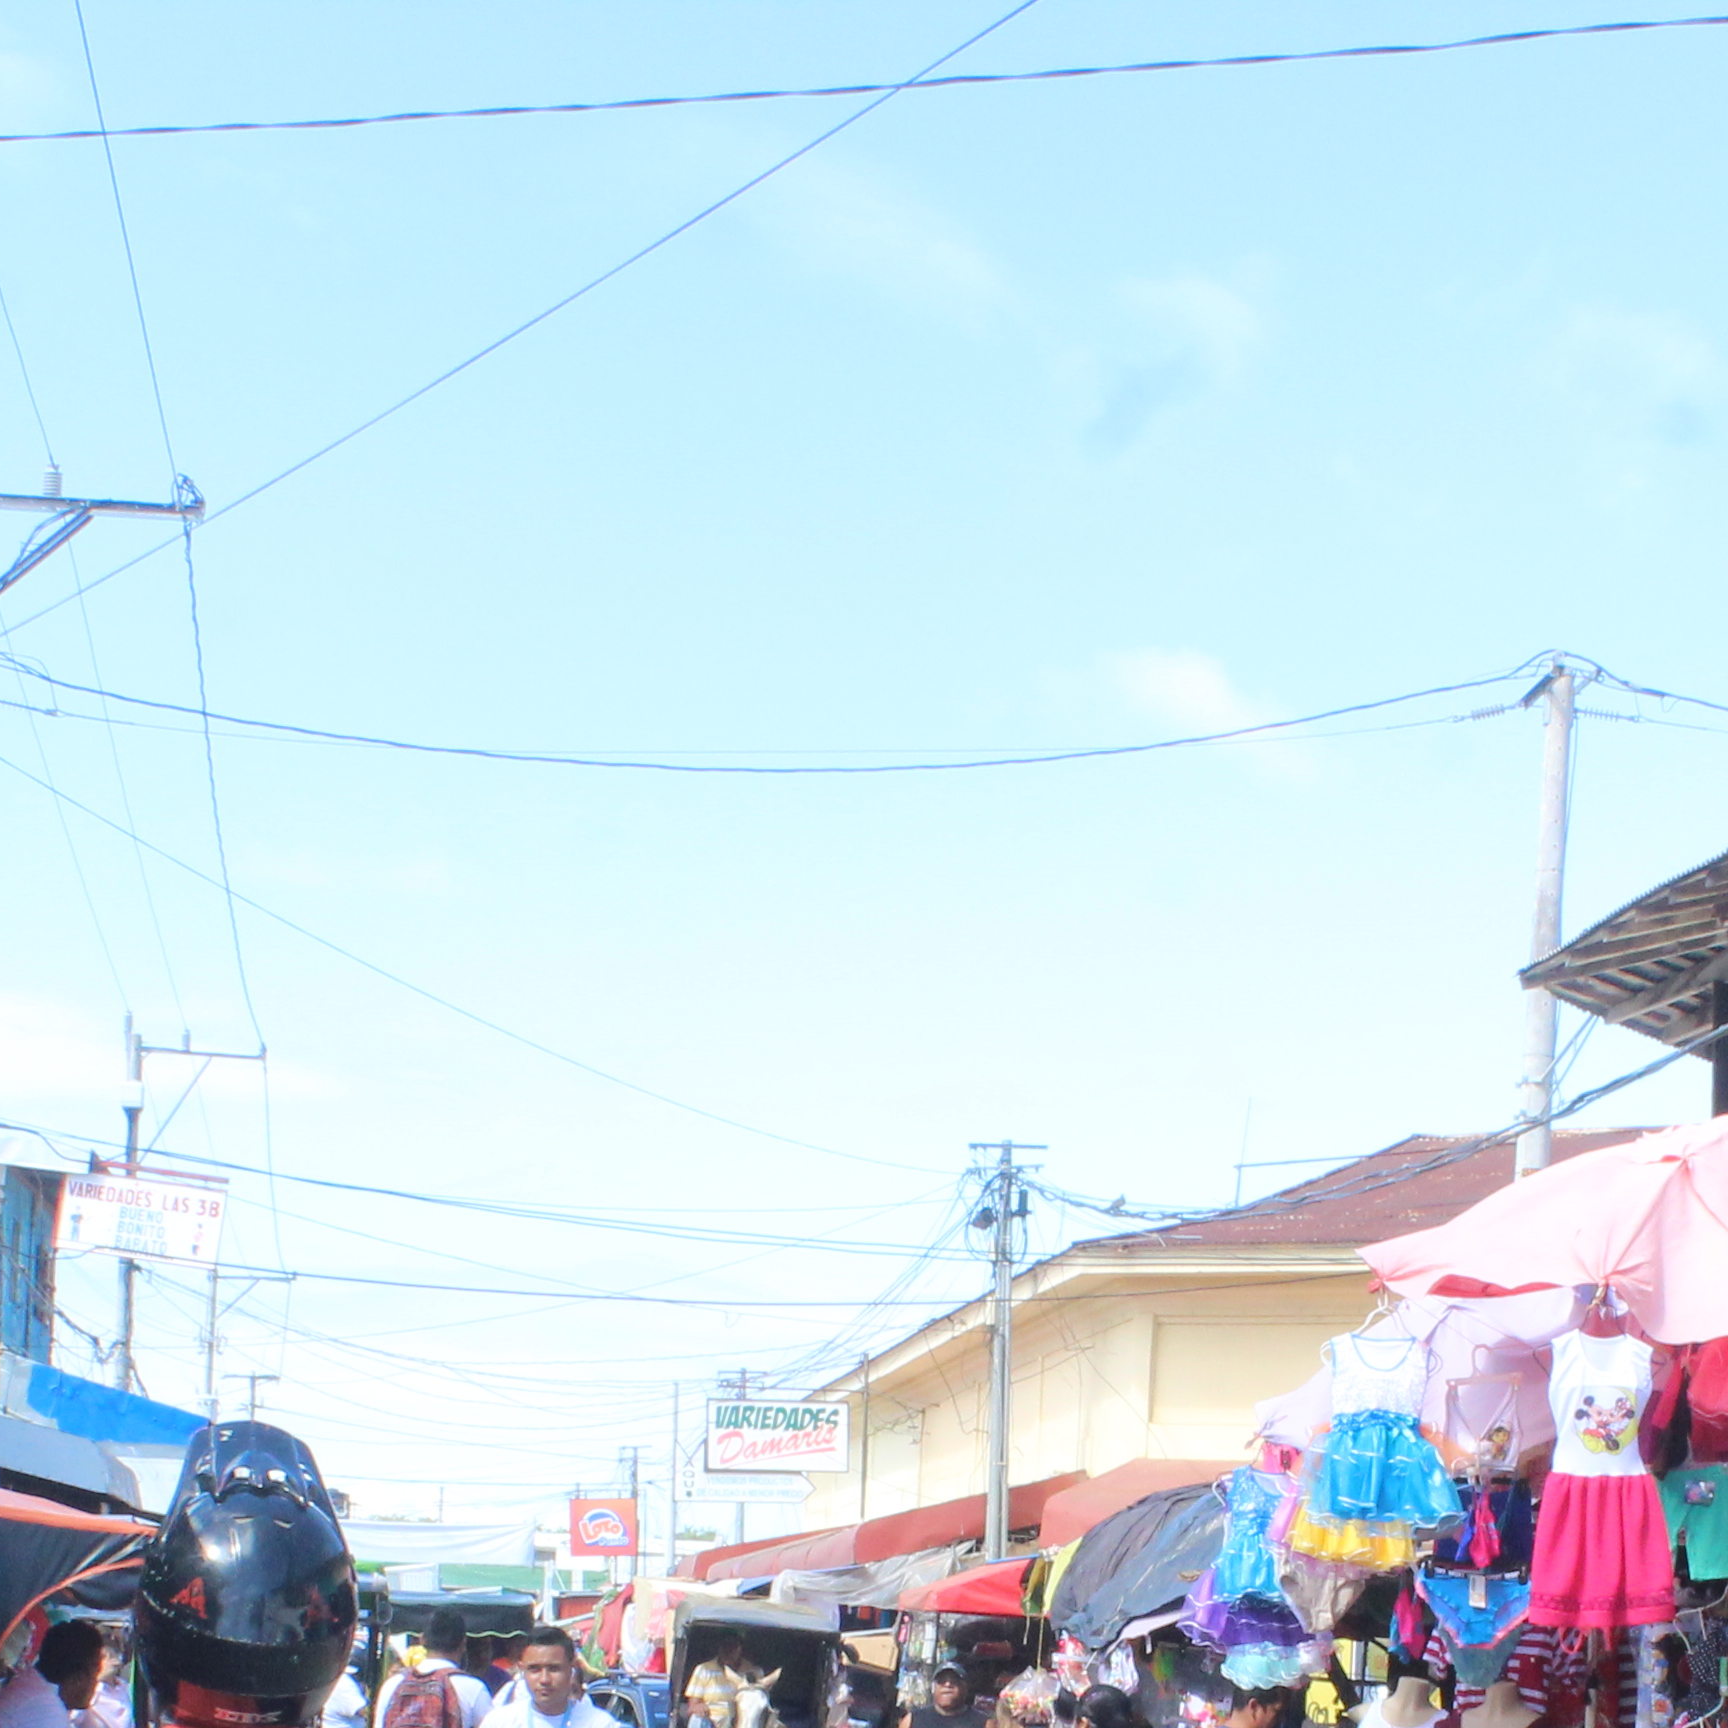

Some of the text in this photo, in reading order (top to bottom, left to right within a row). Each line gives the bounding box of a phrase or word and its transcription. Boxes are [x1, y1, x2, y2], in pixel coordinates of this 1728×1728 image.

[68, 1179, 221, 1218] VARIEDADES LAS 3B
[119, 1206, 164, 1225] BUENO
[117, 1220, 165, 1240] BONITO
[715, 1404, 840, 1432] VARIEDADES
[716, 1424, 837, 1465] Damaris
